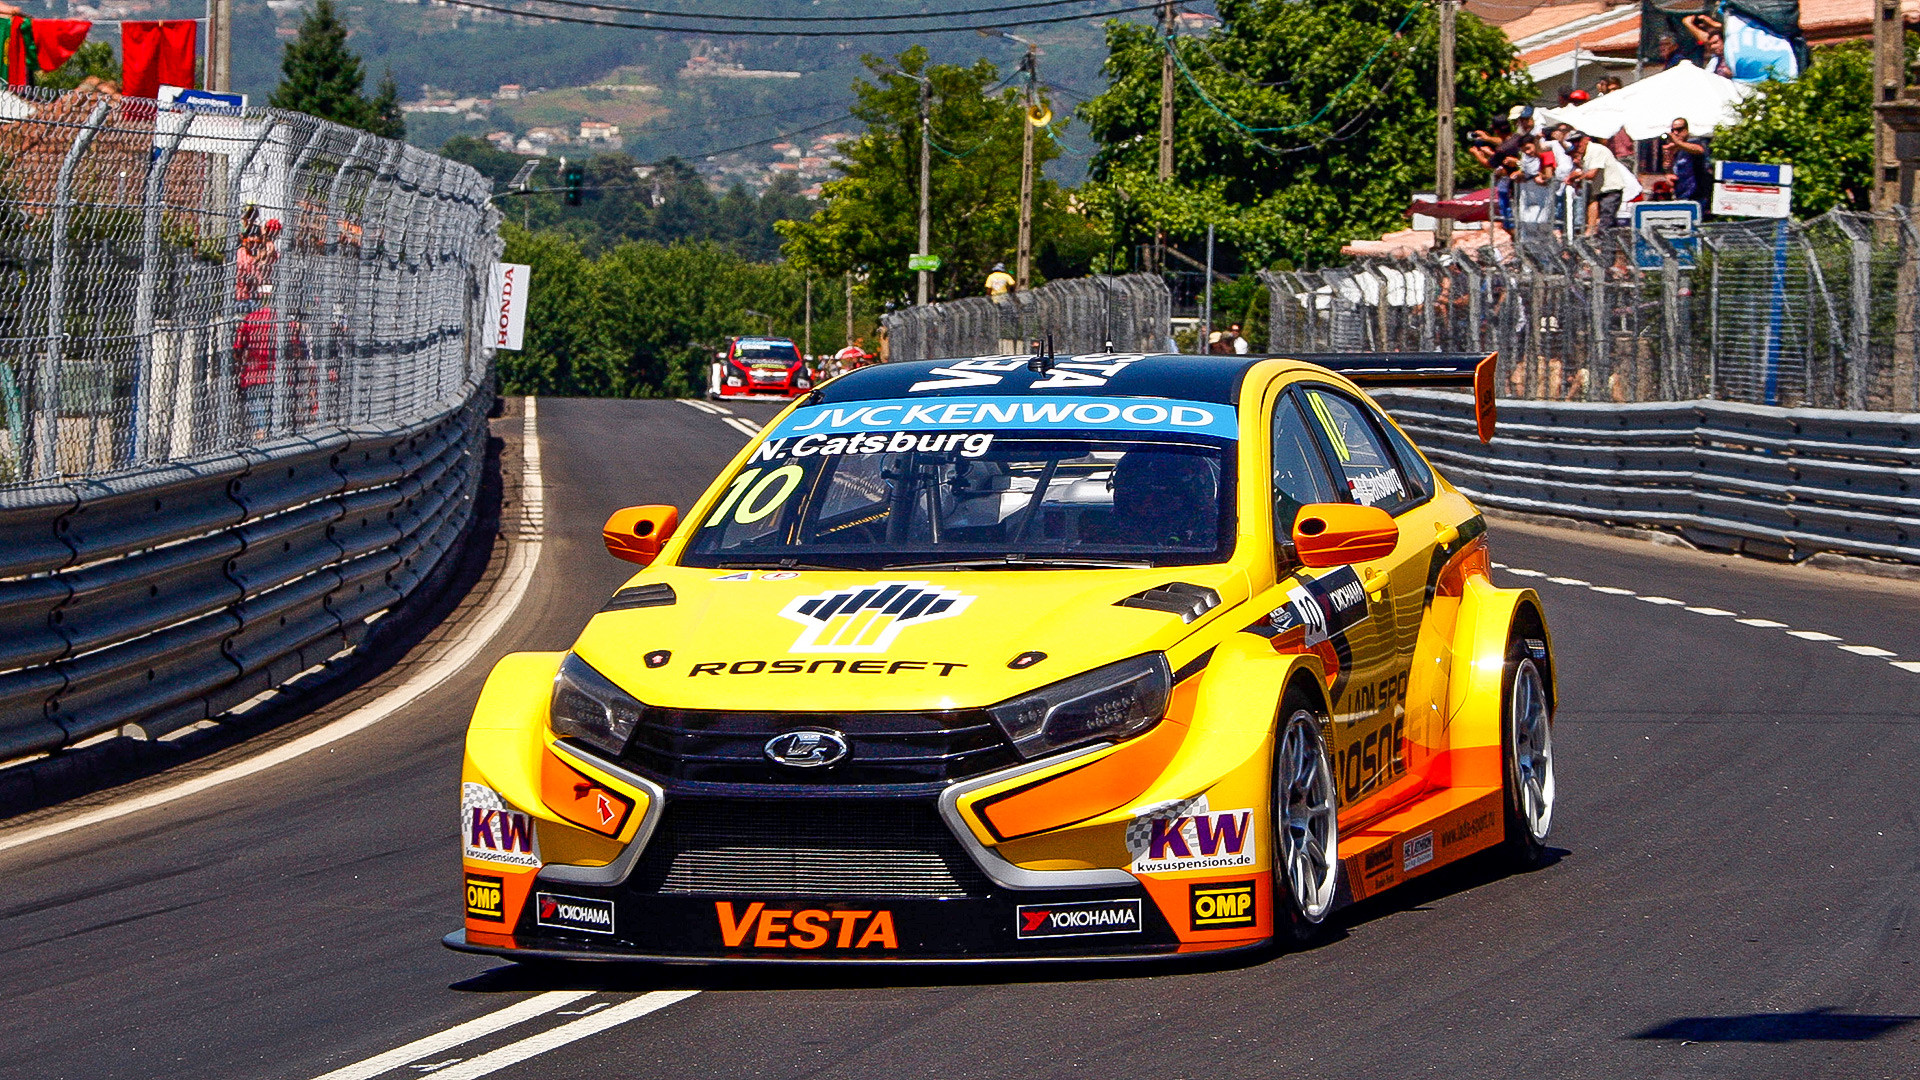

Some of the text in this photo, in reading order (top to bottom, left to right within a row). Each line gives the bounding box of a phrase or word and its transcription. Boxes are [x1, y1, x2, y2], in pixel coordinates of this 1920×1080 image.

[497, 266, 515, 347] HONDA
[703, 464, 804, 528] 10
[1298, 595, 1322, 636] 10
[687, 659, 969, 678] ROSNEFT
[470, 806, 535, 854] KW
[1148, 811, 1252, 862] KW
[466, 846, 538, 867] kwsuspensions.de
[1137, 854, 1251, 872] kwsuspensions.de
[467, 885, 501, 910] OMP
[1195, 893, 1252, 918] OMP
[557, 903, 611, 925] YOKOHAMA
[1049, 908, 1136, 928] YOKOHAMA
